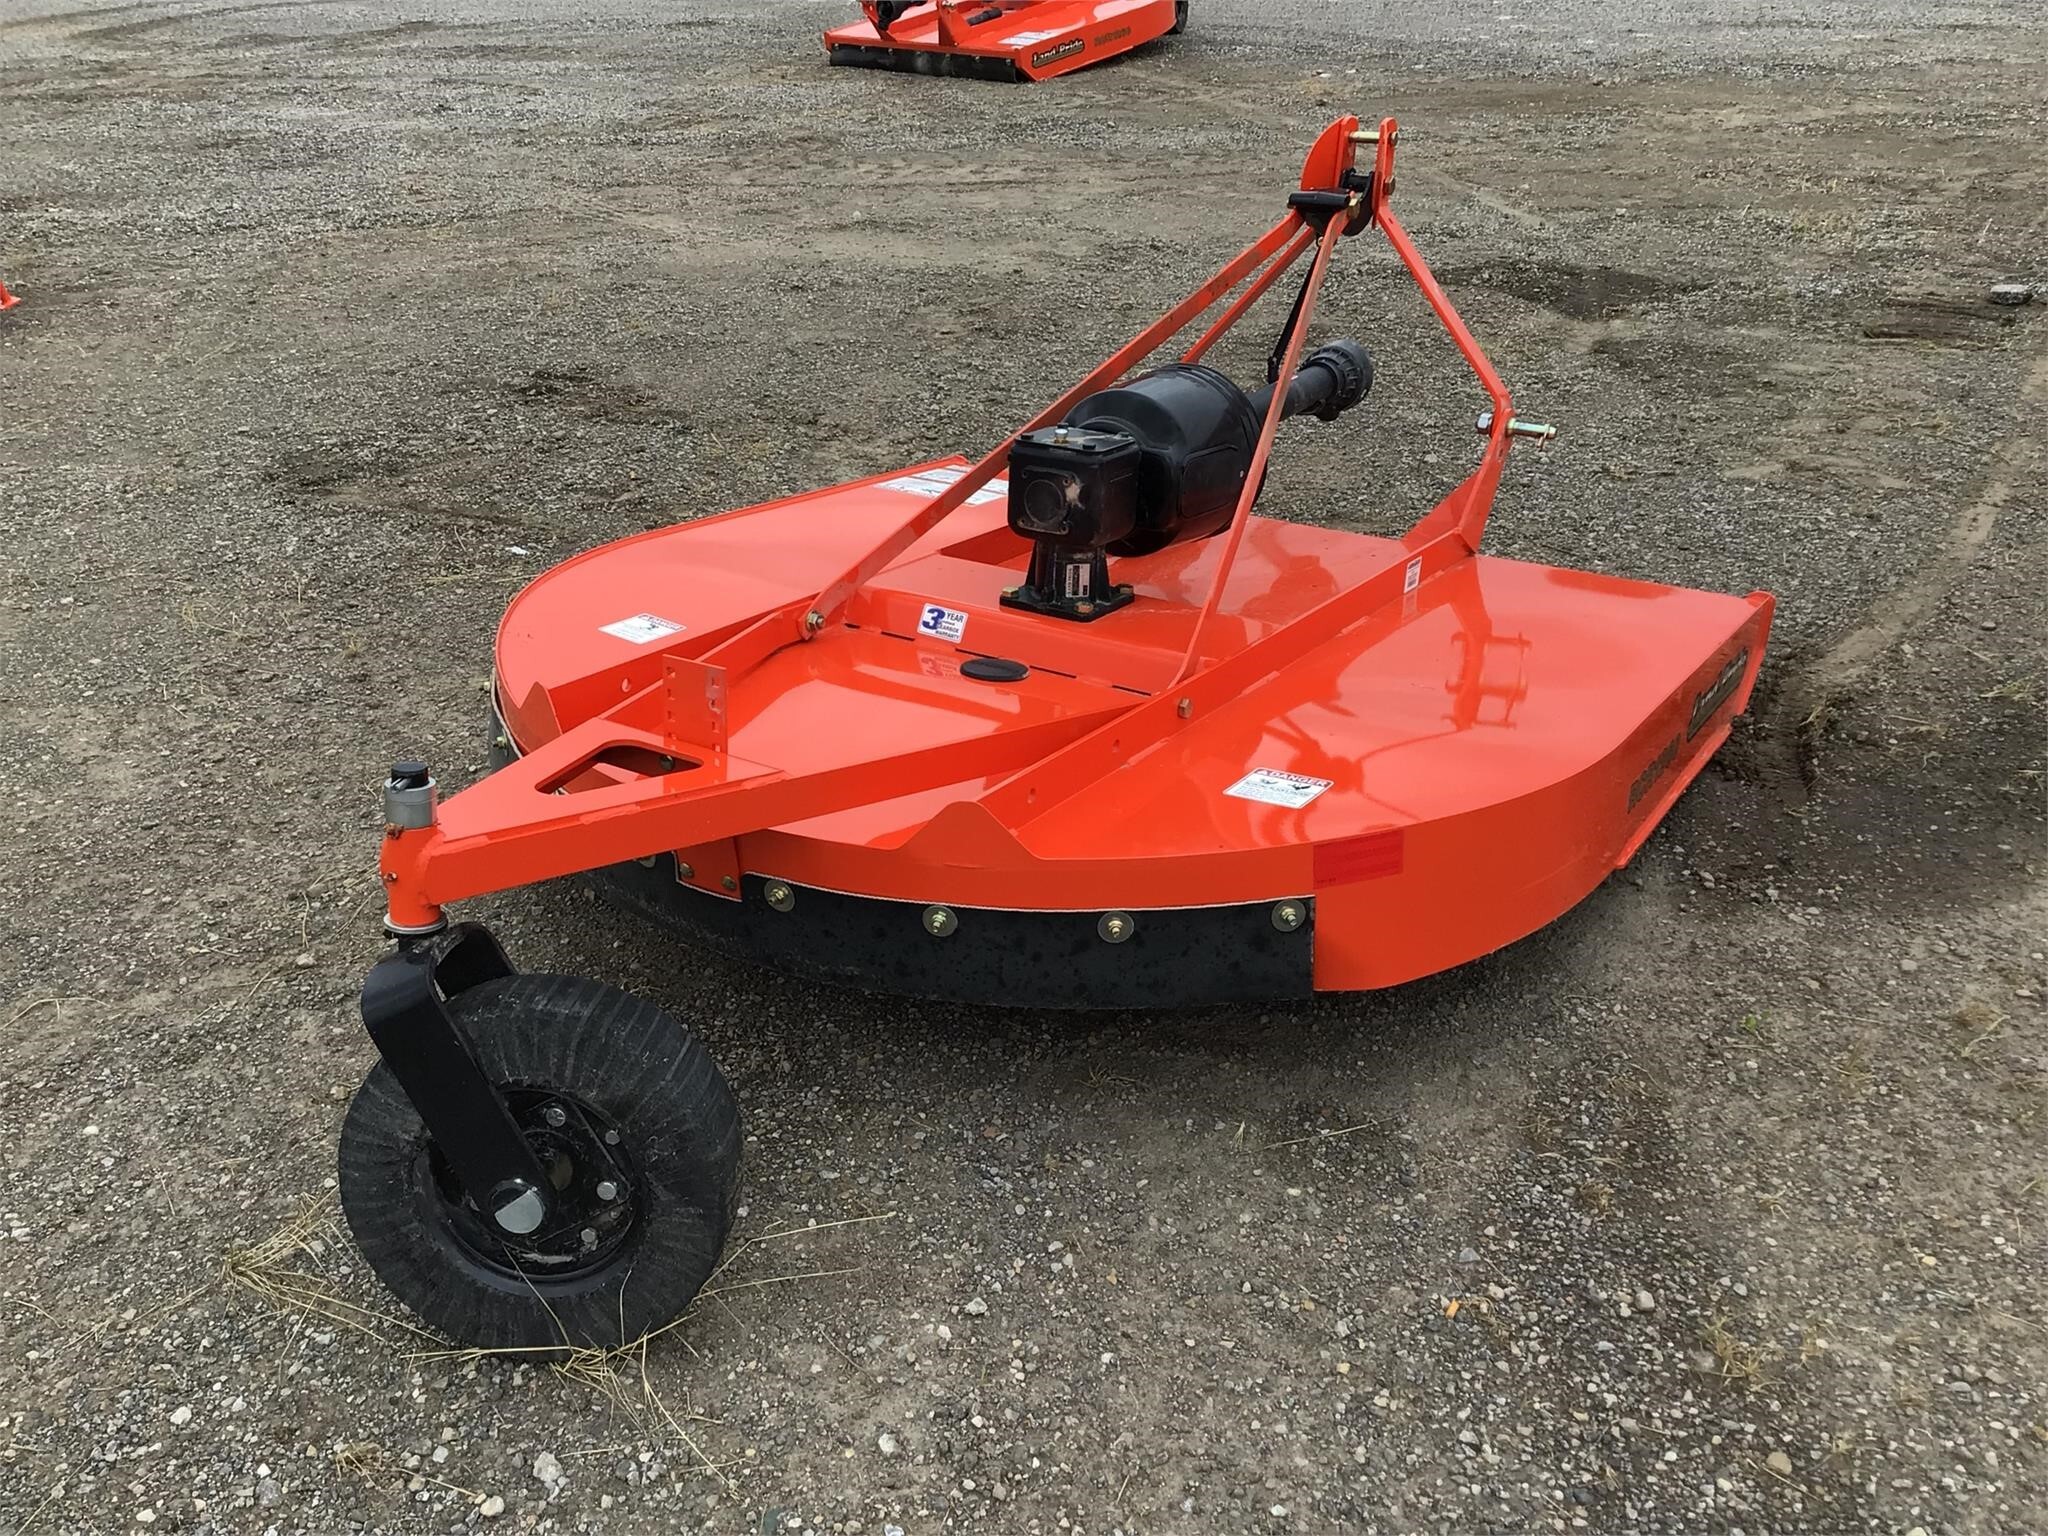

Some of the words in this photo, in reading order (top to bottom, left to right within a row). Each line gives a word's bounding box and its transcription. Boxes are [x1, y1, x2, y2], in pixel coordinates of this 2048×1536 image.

[1033, 47, 1056, 62] Land
[1059, 40, 1083, 53] Pride
[922, 607, 946, 630] 3
[946, 612, 964, 623] YEAR
[1272, 771, 1329, 788] DANGER
